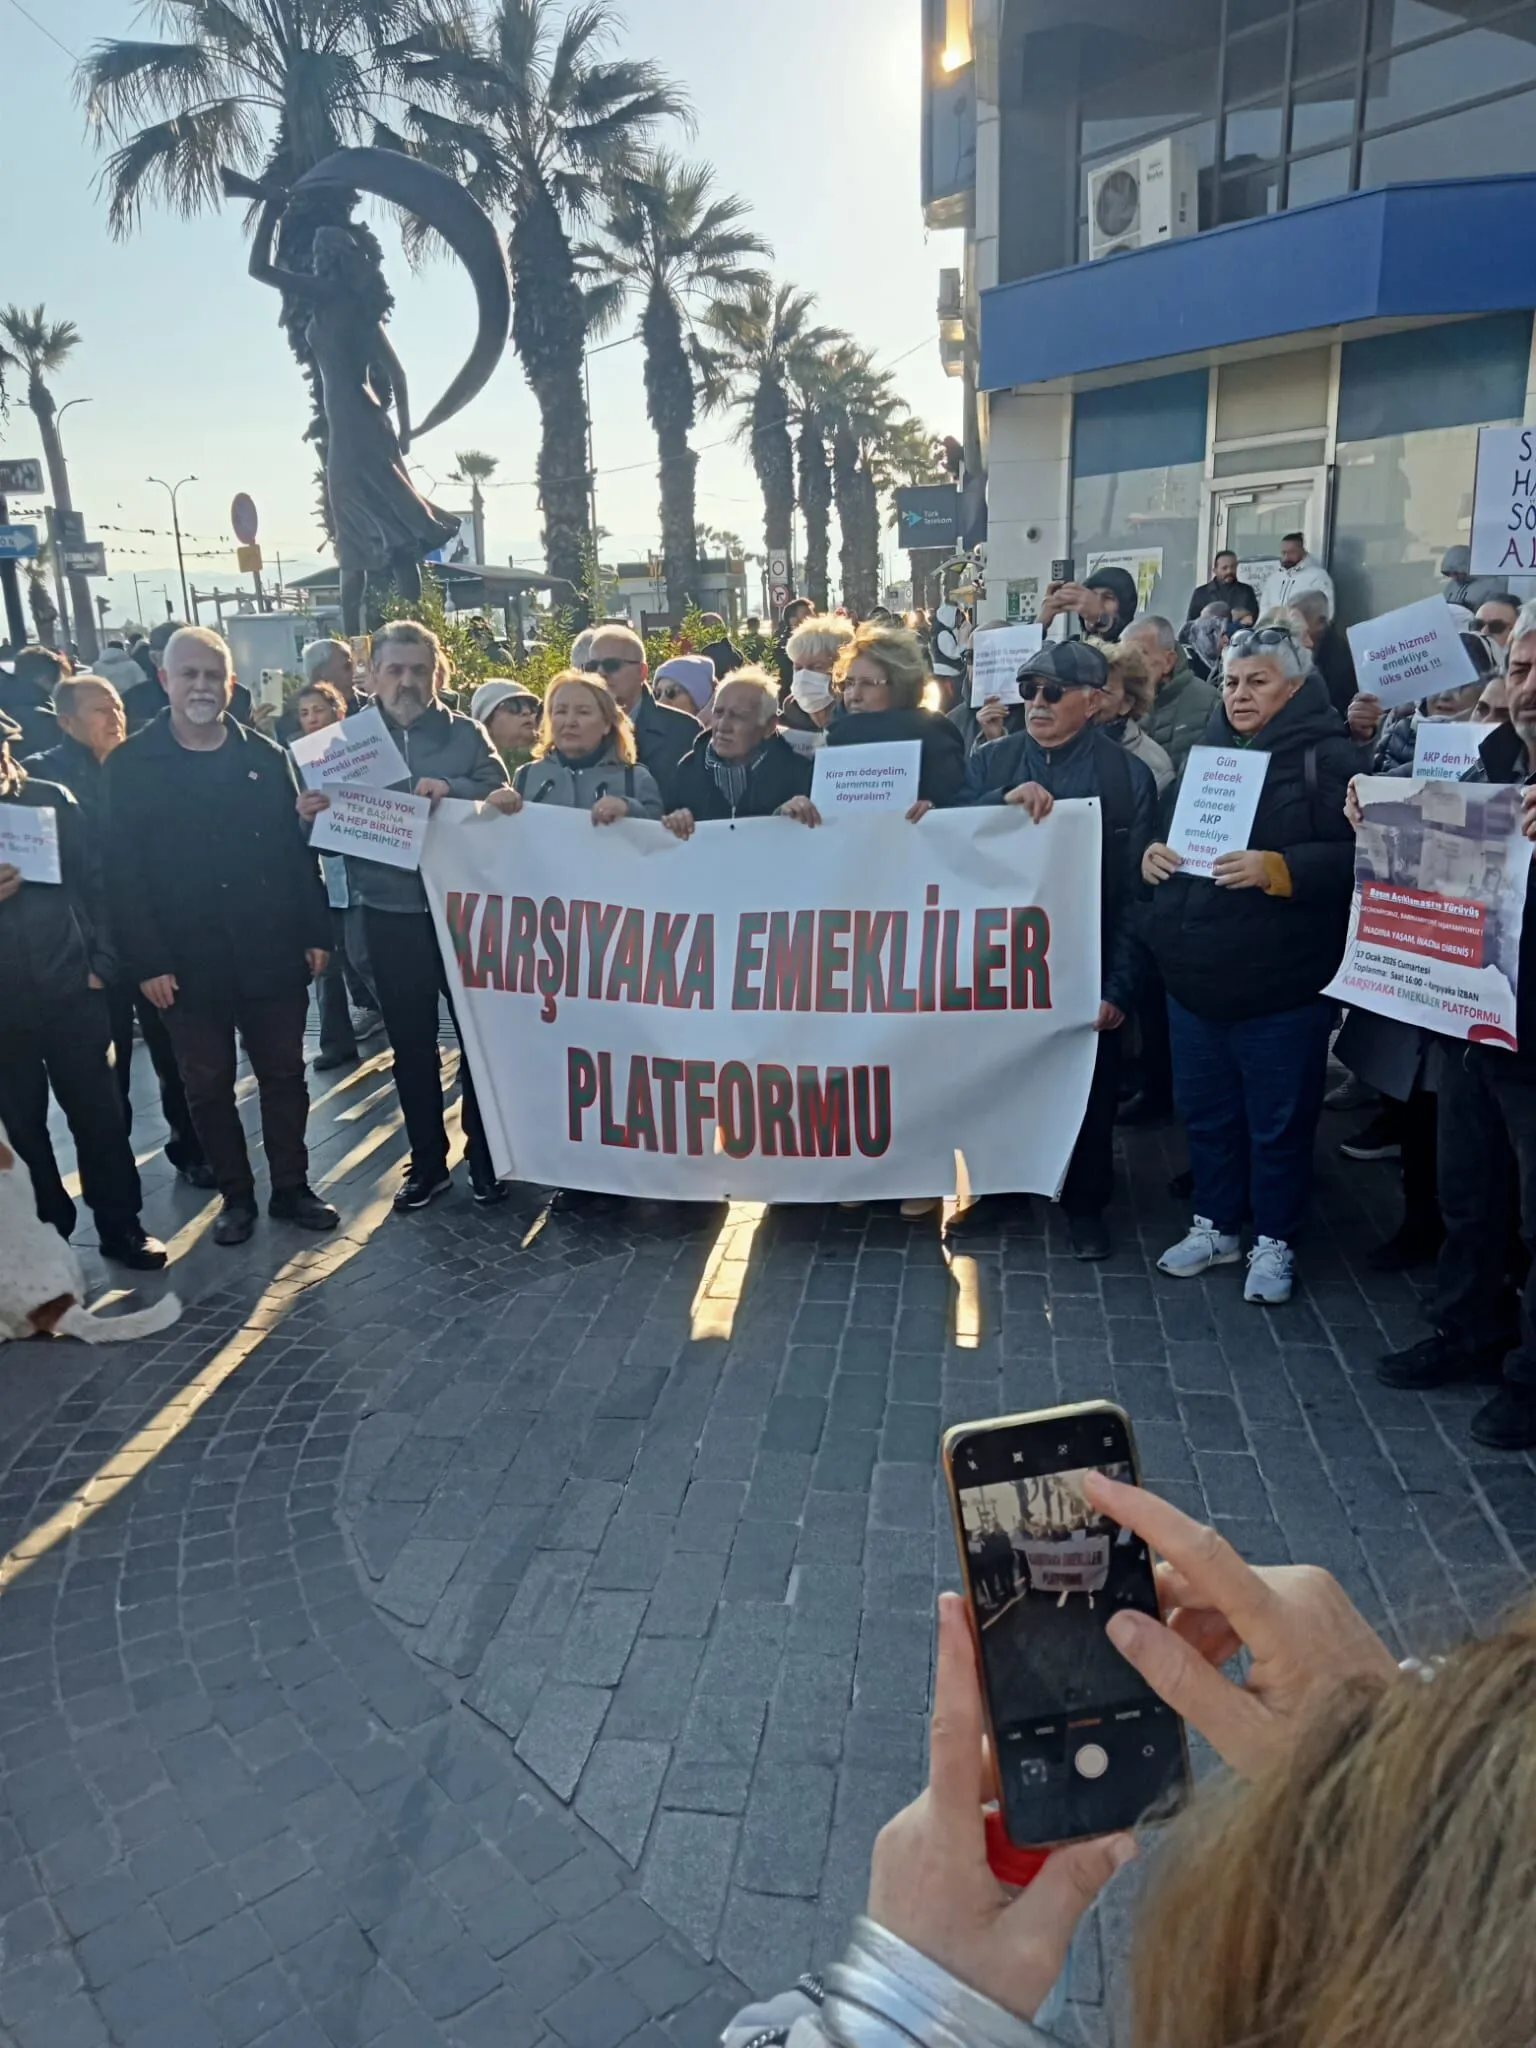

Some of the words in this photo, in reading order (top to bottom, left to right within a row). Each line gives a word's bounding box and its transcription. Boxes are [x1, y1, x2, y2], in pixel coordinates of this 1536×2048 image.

[1519, 431, 1536, 461] S
[1512, 469, 1536, 497] H
[1369, 644, 1398, 662] Sağlık
[1398, 629, 1438, 652] hizmeti
[1382, 649, 1430, 672] emekliye
[1379, 672, 1402, 687] lüks
[1403, 663, 1430, 679] oldu
[322, 758, 352, 777] emekli
[1216, 756, 1237, 768] Gün
[1423, 751, 1441, 763] AKP
[1441, 752, 1461, 765] den
[825, 770, 844, 780] Kira
[1202, 770, 1243, 784] gelecek
[1416, 766, 1454, 779] emekliler
[338, 789, 392, 811] KURTULUŞ
[394, 802, 416, 815] YOK
[1201, 785, 1236, 798] devran
[346, 802, 366, 814] TEK
[1193, 798, 1237, 813] dönecek
[332, 811, 346, 822] YA
[346, 815, 369, 827] HEP
[369, 819, 414, 839] BİRLİKTE
[1199, 813, 1222, 825] AKP
[329, 822, 342, 834] YA
[343, 825, 401, 848] HİÇBİRİMİZ
[1184, 827, 1230, 842] emekliye
[1187, 841, 1218, 857] hesap
[1443, 901, 1480, 919] Yürüyüş
[446, 891, 714, 1023] KARŞIYAKA
[731, 884, 1053, 1013] EMEKLİLER
[1365, 950, 1381, 963] Ocak
[1397, 959, 1431, 975] Cumartesi
[1390, 971, 1404, 982] Saat
[1405, 975, 1423, 987] 16:00
[1457, 985, 1480, 1002] İZBAN
[1342, 974, 1395, 998] KARŞIYAKA
[1441, 1000, 1502, 1024] PLATFORMU
[567, 1046, 892, 1158] PLATFORMU
